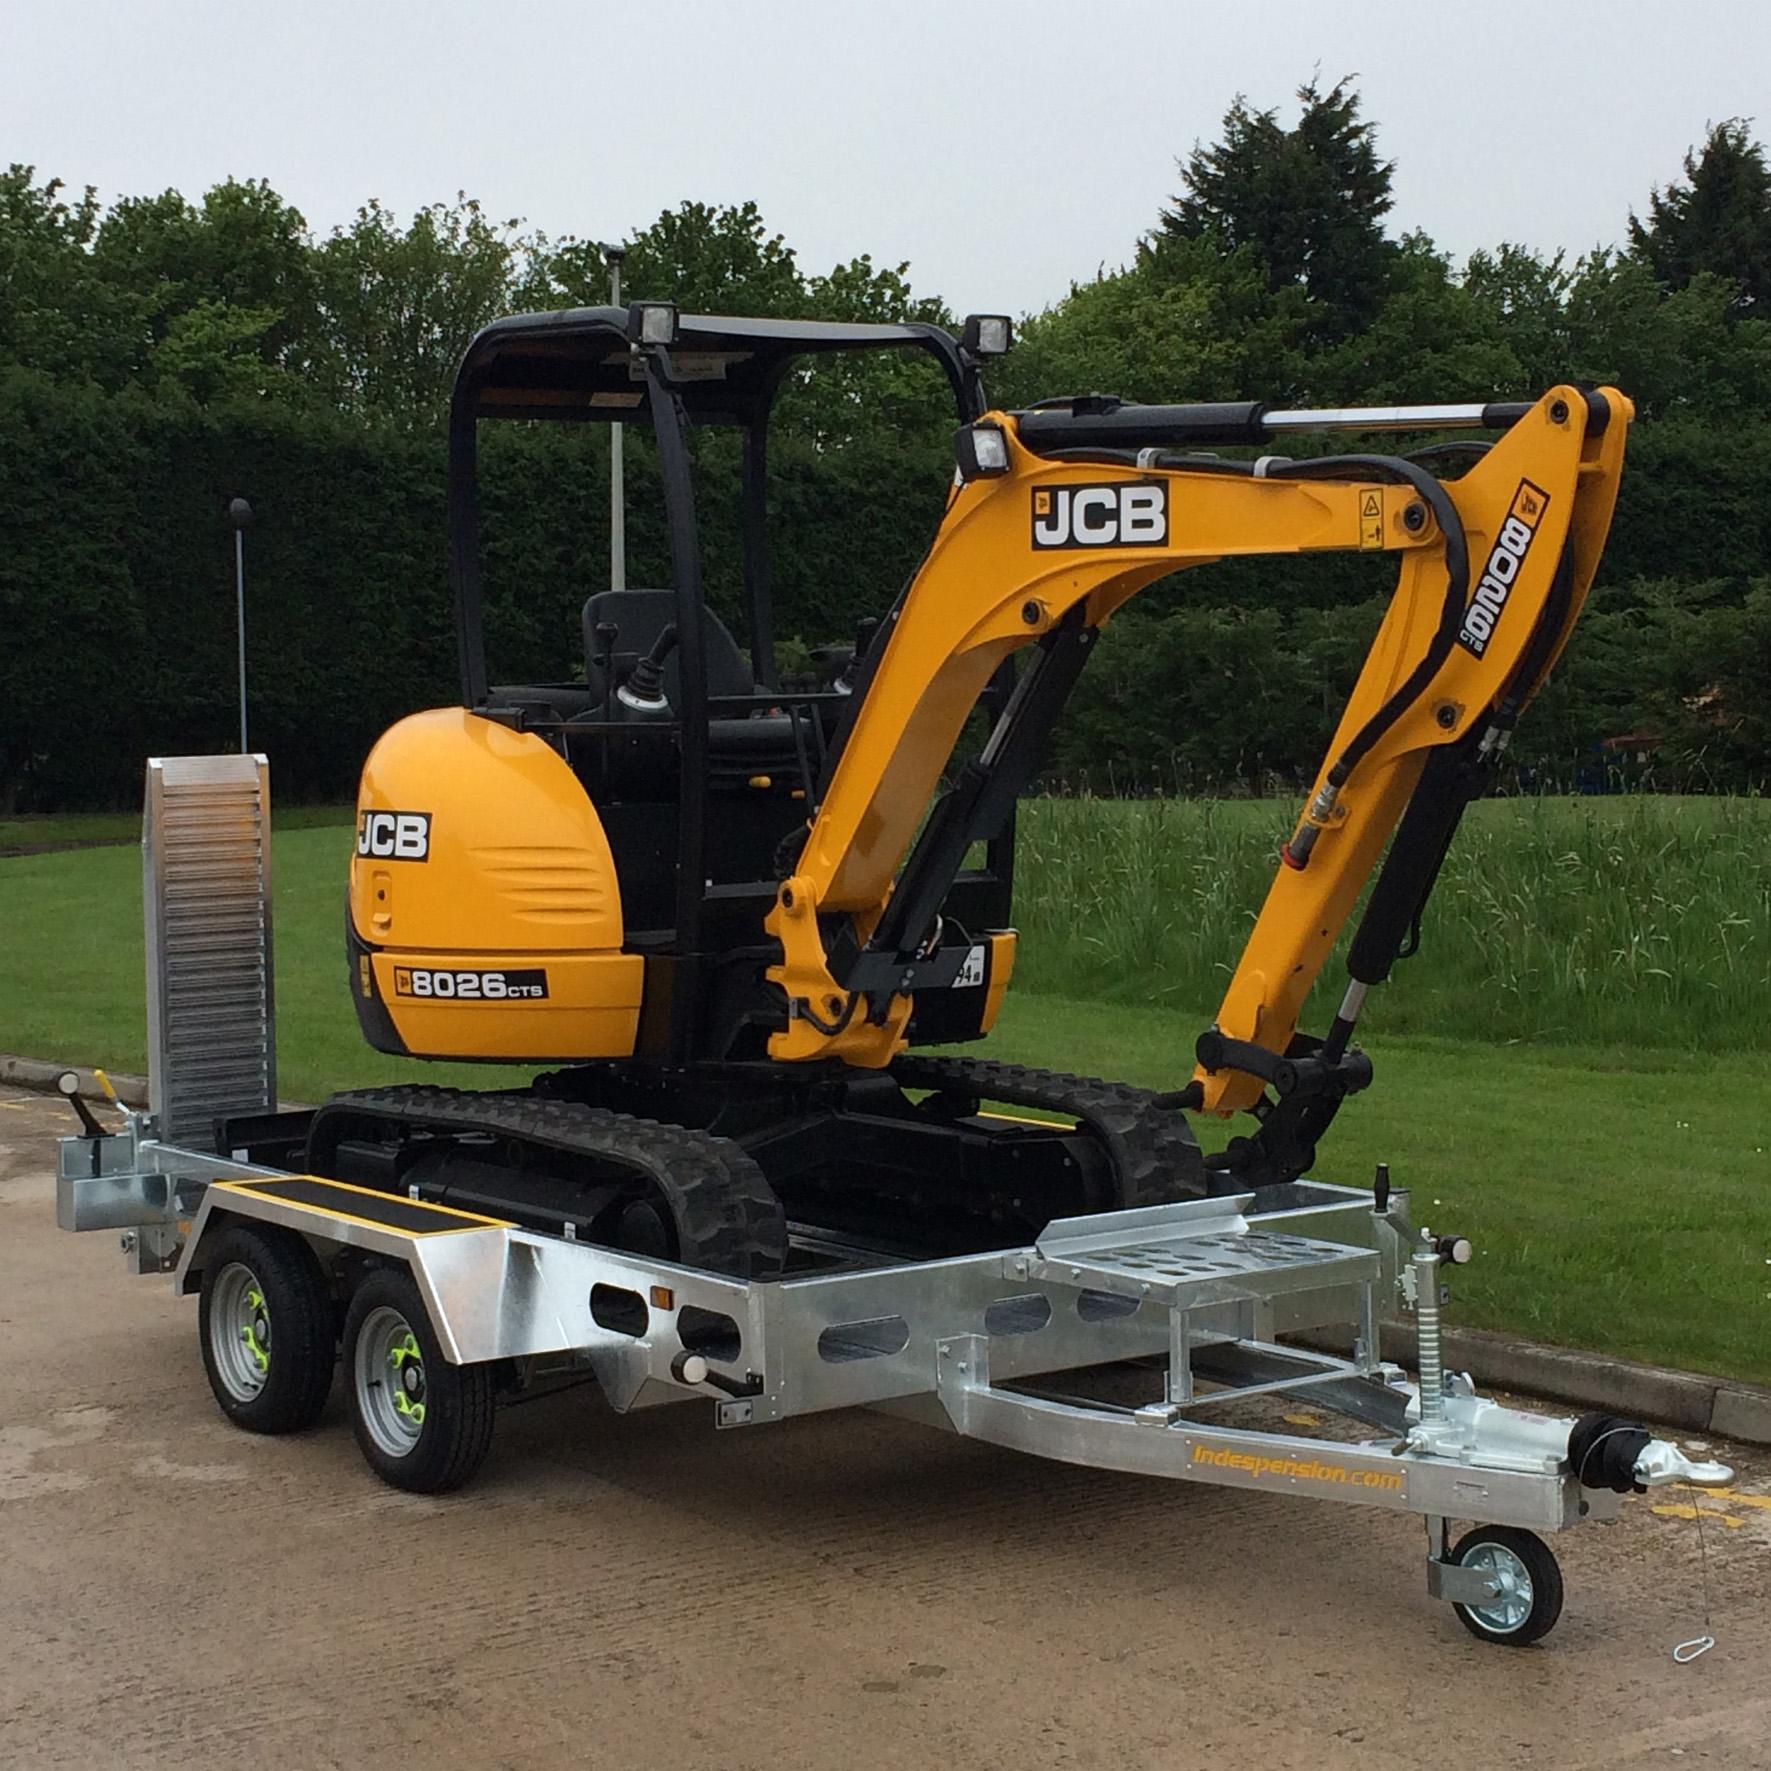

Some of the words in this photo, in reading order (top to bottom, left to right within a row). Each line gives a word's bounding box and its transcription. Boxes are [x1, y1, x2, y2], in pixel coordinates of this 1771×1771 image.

[1035, 486, 1166, 545] JCB
[358, 814, 428, 858] JCB
[1193, 1445, 1402, 1489] Indespension.com
